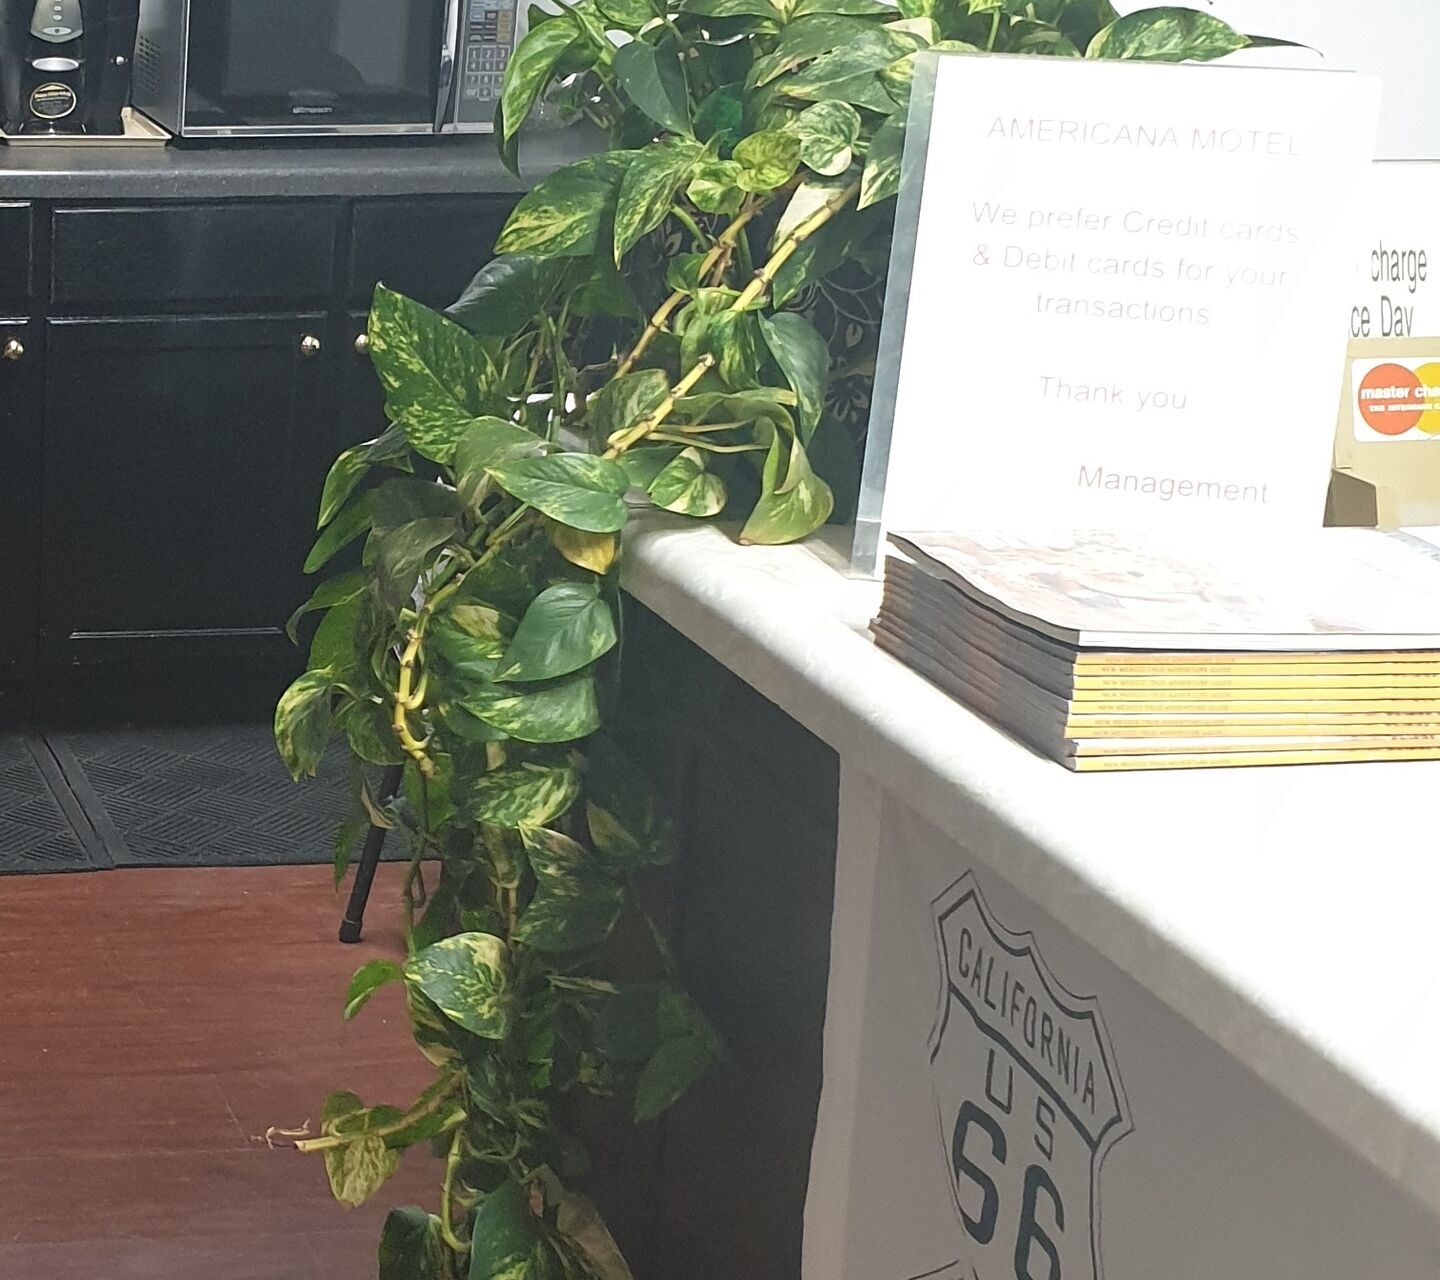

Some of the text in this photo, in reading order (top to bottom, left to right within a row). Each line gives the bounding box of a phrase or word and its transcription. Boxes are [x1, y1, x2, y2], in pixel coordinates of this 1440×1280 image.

[986, 116, 1302, 157] AMERICANA MOTEL
[972, 200, 1300, 245] We prefer Credit cards
[972, 243, 1289, 291] & Debit cards for your
[1371, 240, 1427, 293] charge
[1035, 291, 1211, 327] transactions
[1039, 375, 1189, 413] Thank you
[1360, 376, 1411, 401] master
[1076, 464, 1270, 504] Management
[958, 927, 1097, 1115] CALIFORNIA
